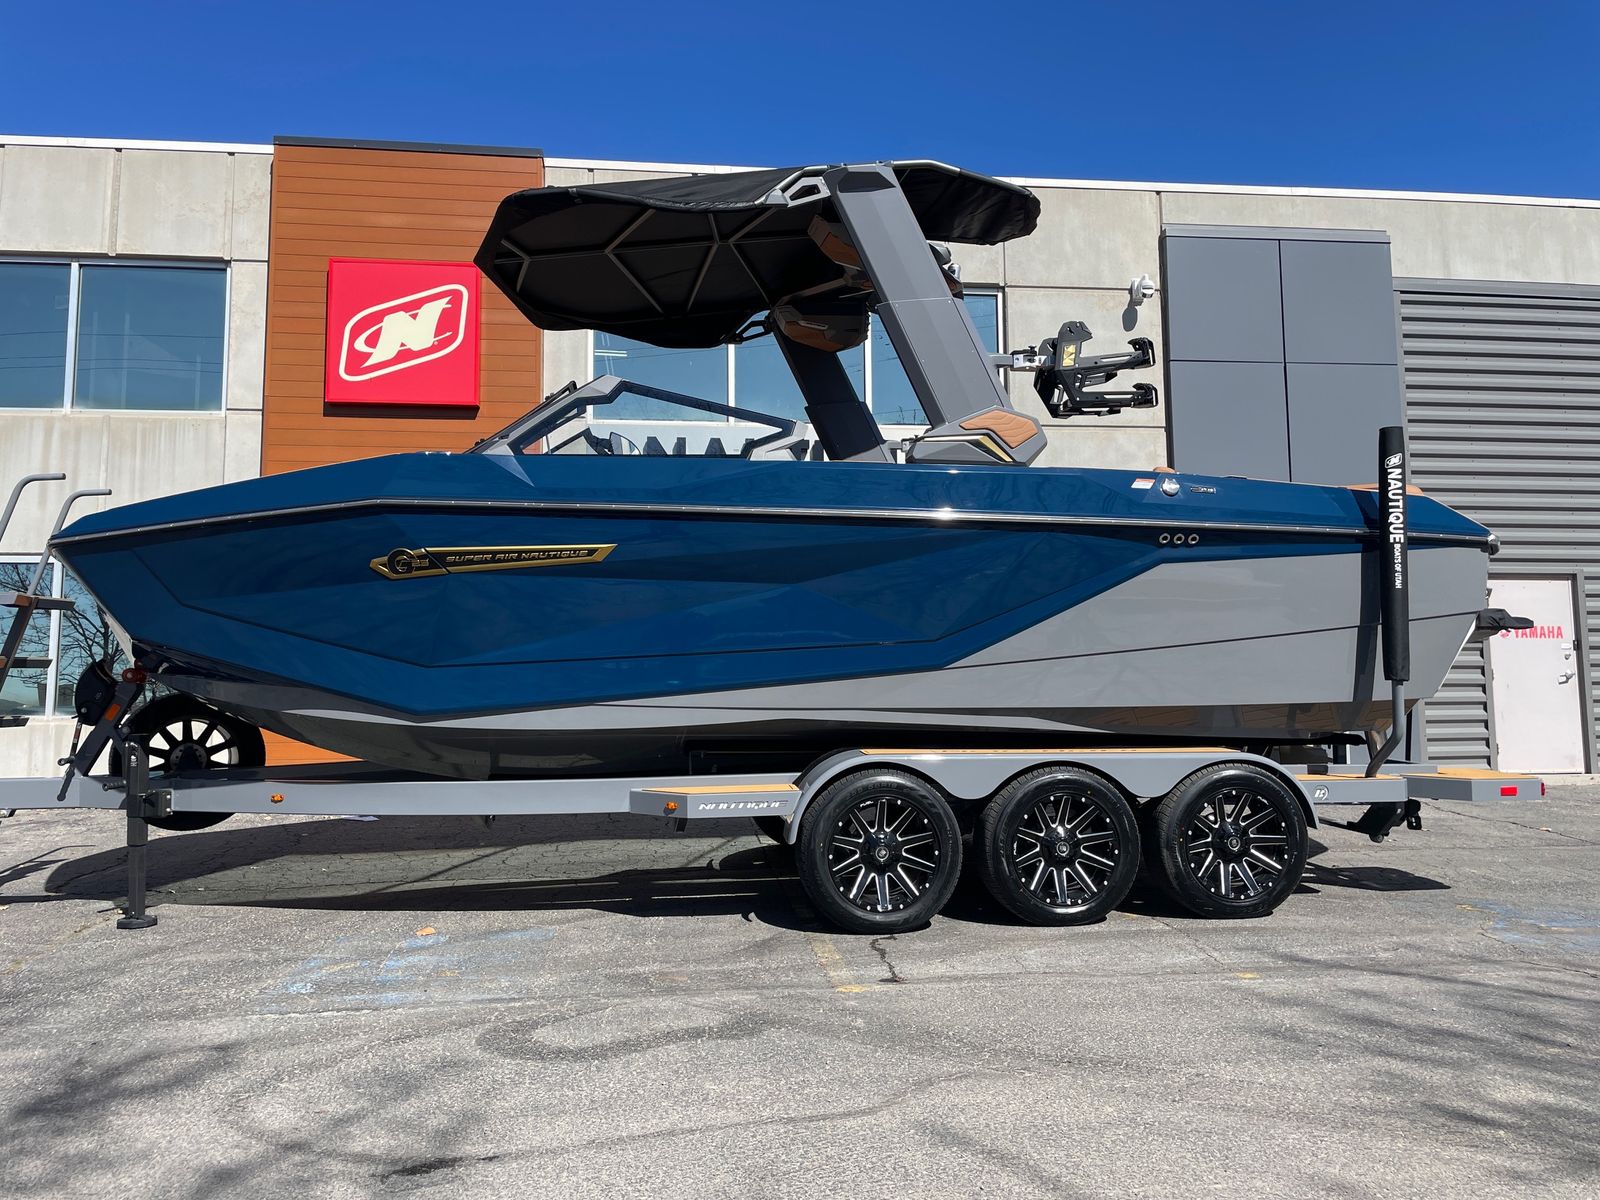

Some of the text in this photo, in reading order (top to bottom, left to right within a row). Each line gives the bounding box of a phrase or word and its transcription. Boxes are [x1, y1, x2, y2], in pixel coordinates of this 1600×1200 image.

[1388, 468, 1404, 589] NAUTIQUE BOATS OF UTAH
[445, 550, 589, 563] SUPER AIR NAUTIQUE
[1514, 626, 1564, 639] YAMAHA
[699, 800, 789, 810] NAUTIQUE
